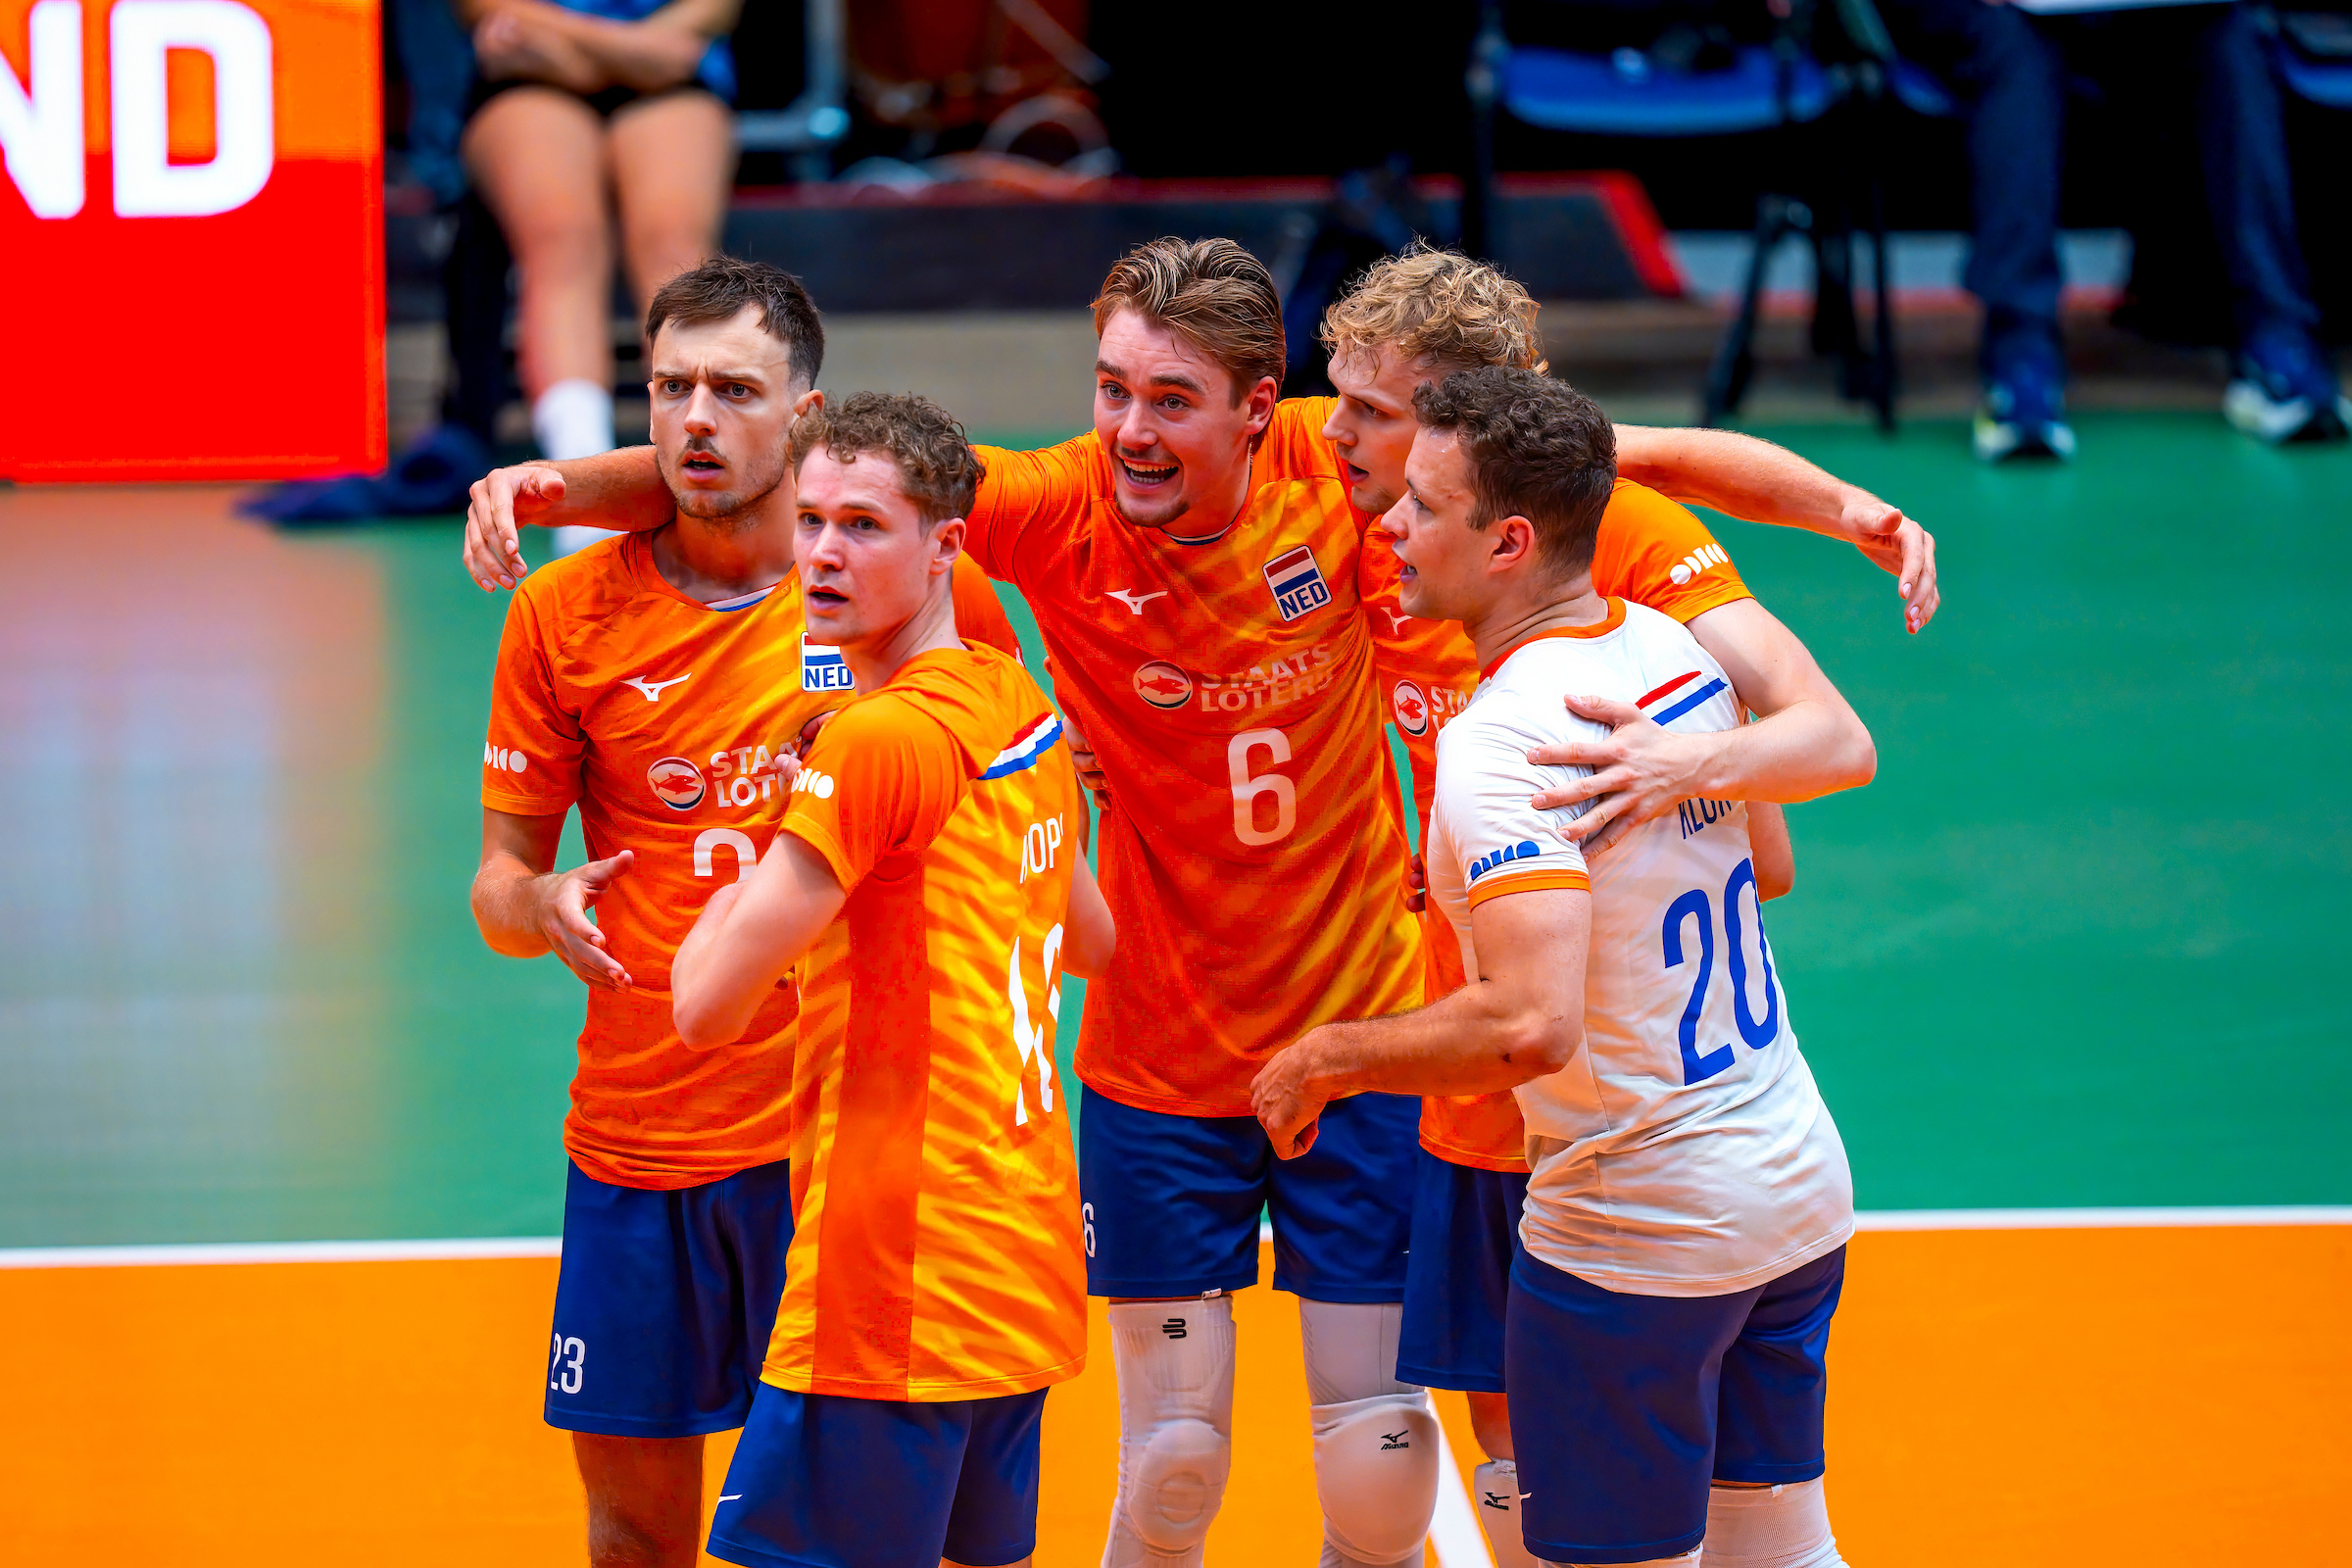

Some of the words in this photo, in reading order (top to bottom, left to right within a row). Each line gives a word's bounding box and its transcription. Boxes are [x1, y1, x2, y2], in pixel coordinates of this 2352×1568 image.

[1279, 581, 1328, 618] NED
[805, 666, 853, 688] NED
[1431, 686, 1467, 715] STA
[710, 741, 798, 778] STA
[713, 772, 788, 808] LOT
[1227, 727, 1298, 847] 6
[1663, 858, 1779, 1087] 20
[1082, 1201, 1097, 1258] 6
[550, 1332, 586, 1395] 23
